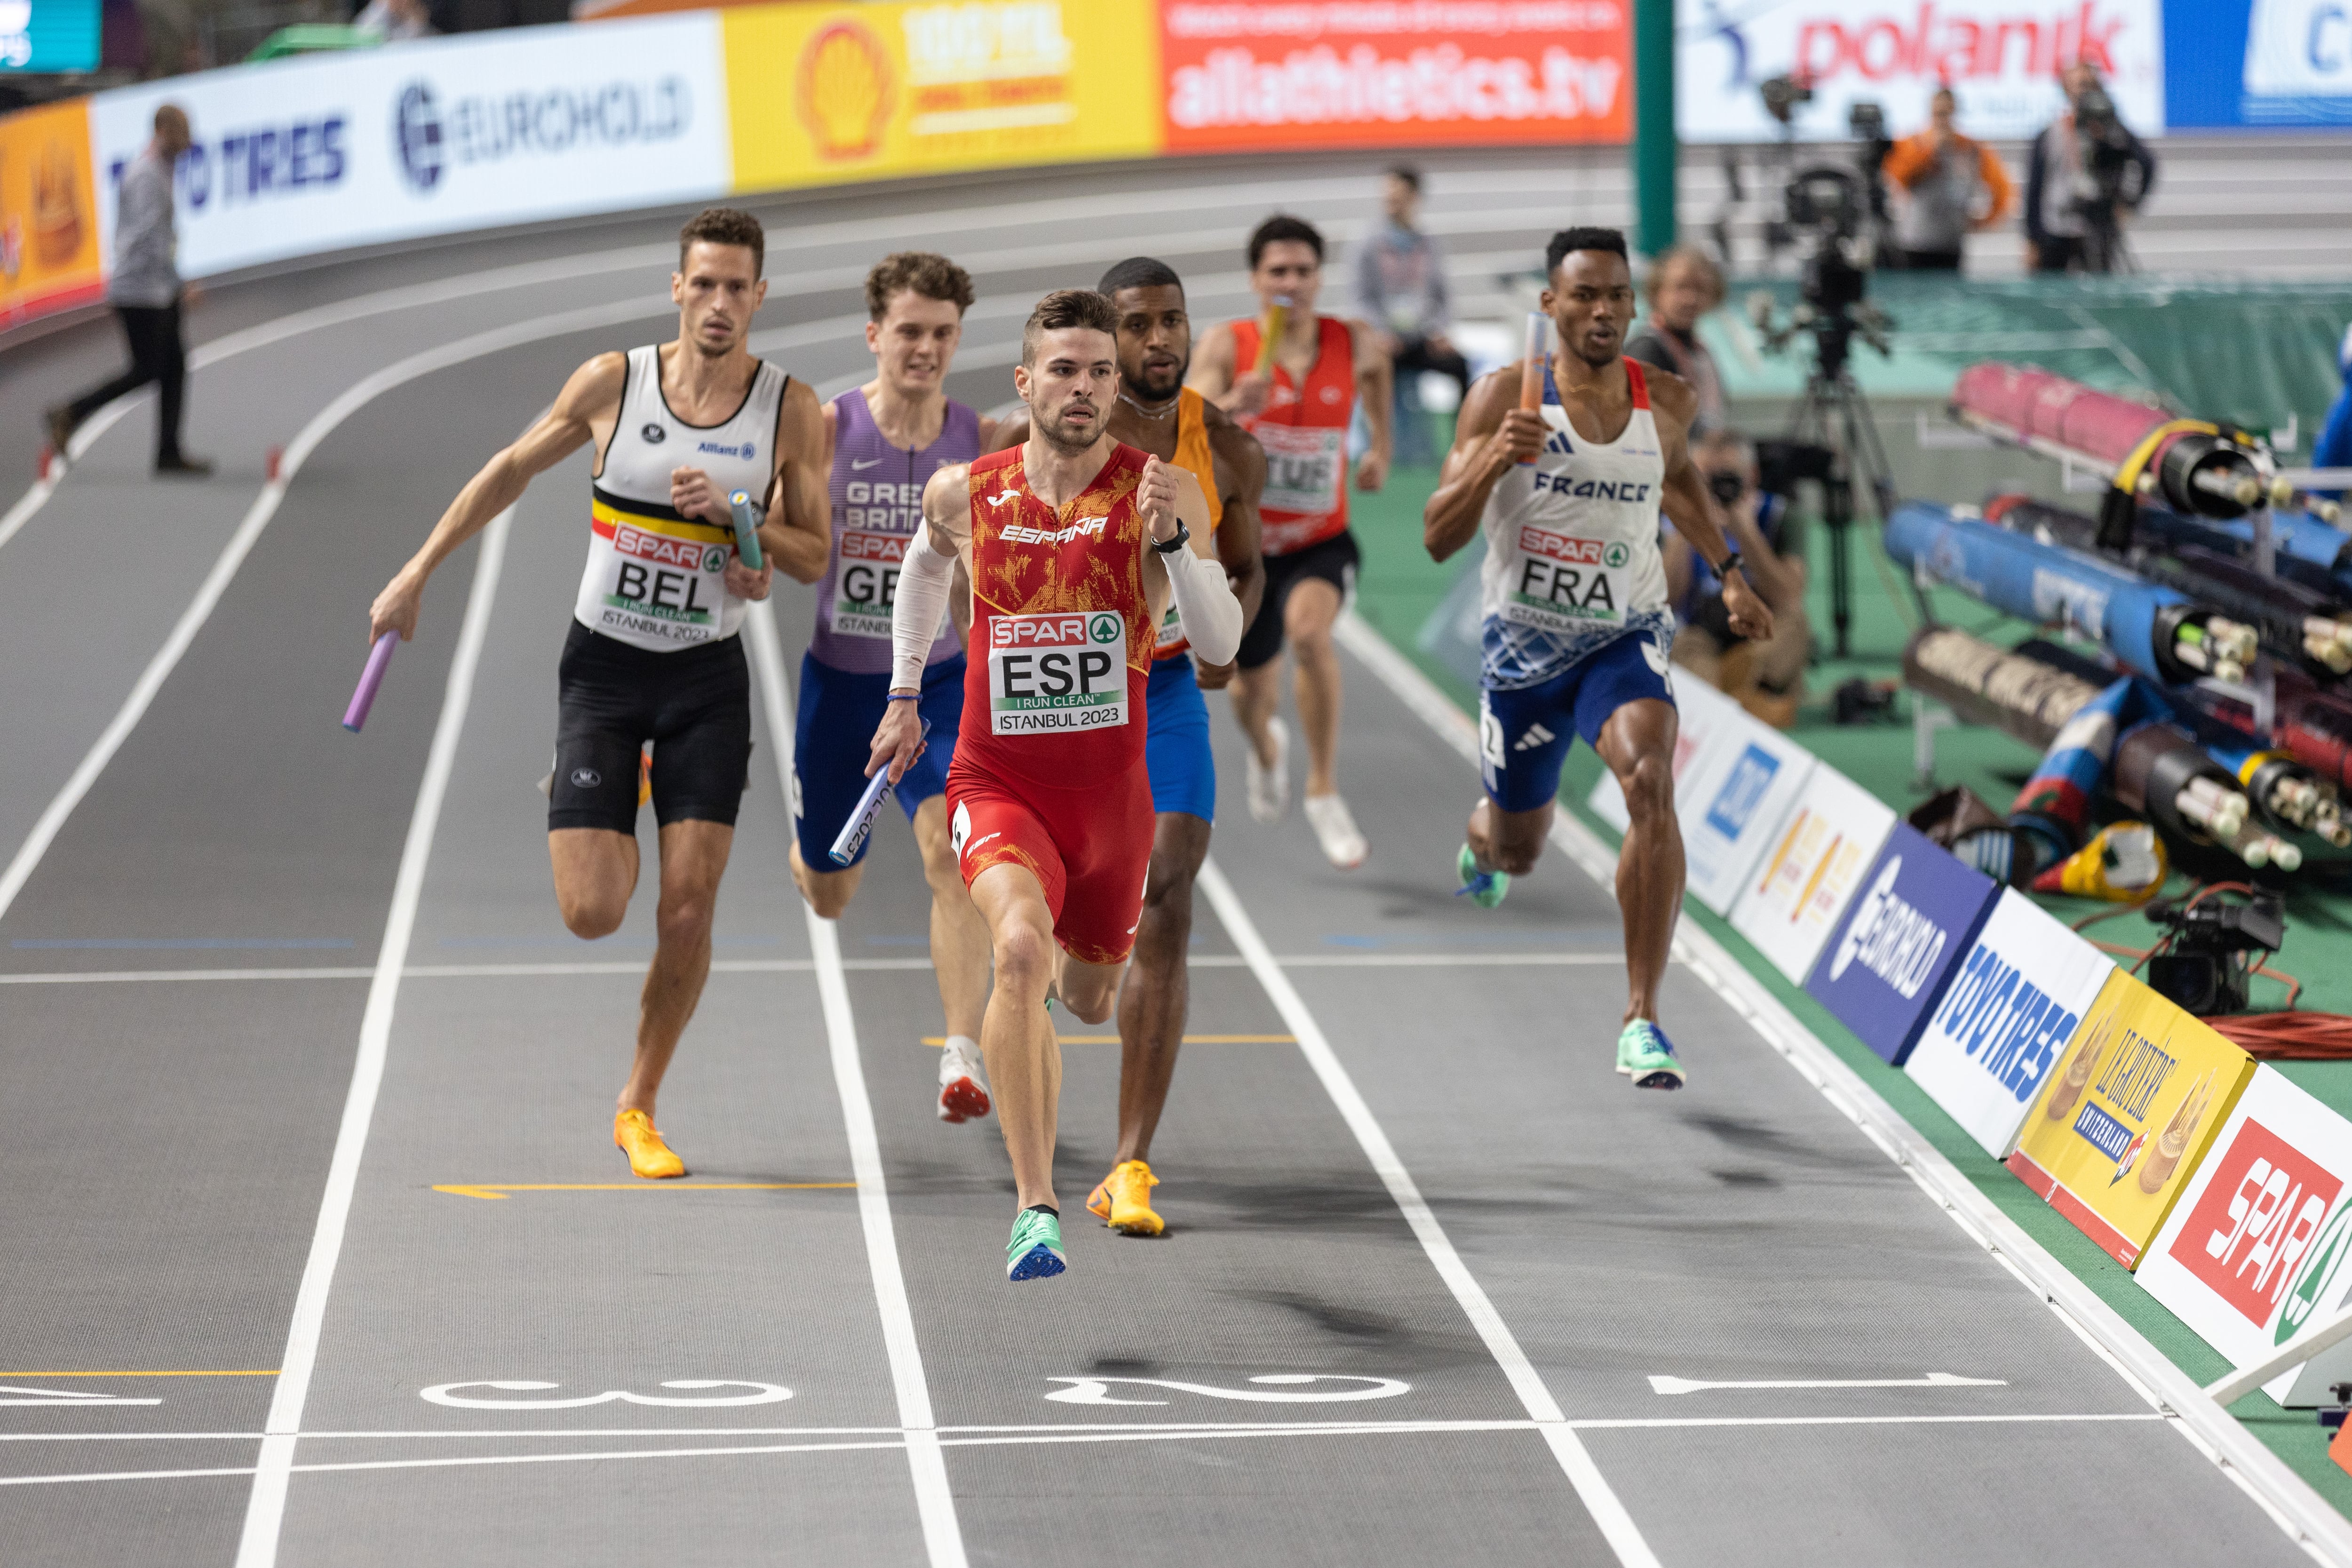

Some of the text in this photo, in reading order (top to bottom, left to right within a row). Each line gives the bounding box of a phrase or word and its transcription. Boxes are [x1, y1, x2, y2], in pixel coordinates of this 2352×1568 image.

[698, 442, 738, 456] Allianz
[1534, 471, 1650, 502] FRANCE
[617, 530, 699, 568] SPAR
[999, 517, 1109, 546] ESPAÑA
[1521, 531, 1600, 562] SPAR
[616, 561, 708, 614] BEL
[1520, 558, 1615, 612] FRA
[995, 620, 1084, 644] SPAR
[1002, 652, 1112, 698] ESP
[1000, 708, 1119, 729] ISTANBUL 2023
[1017, 699, 1020, 708] I
[1024, 697, 1050, 708] RUN
[966, 832, 1001, 859] ESP
[1856, 893, 1947, 999] EUROHOLD
[1935, 943, 2078, 1104] TOYO TIRES
[2096, 1028, 2137, 1095] LE
[2077, 1106, 2130, 1157] SWITZERLAND
[2206, 1157, 2325, 1304] SPAR
